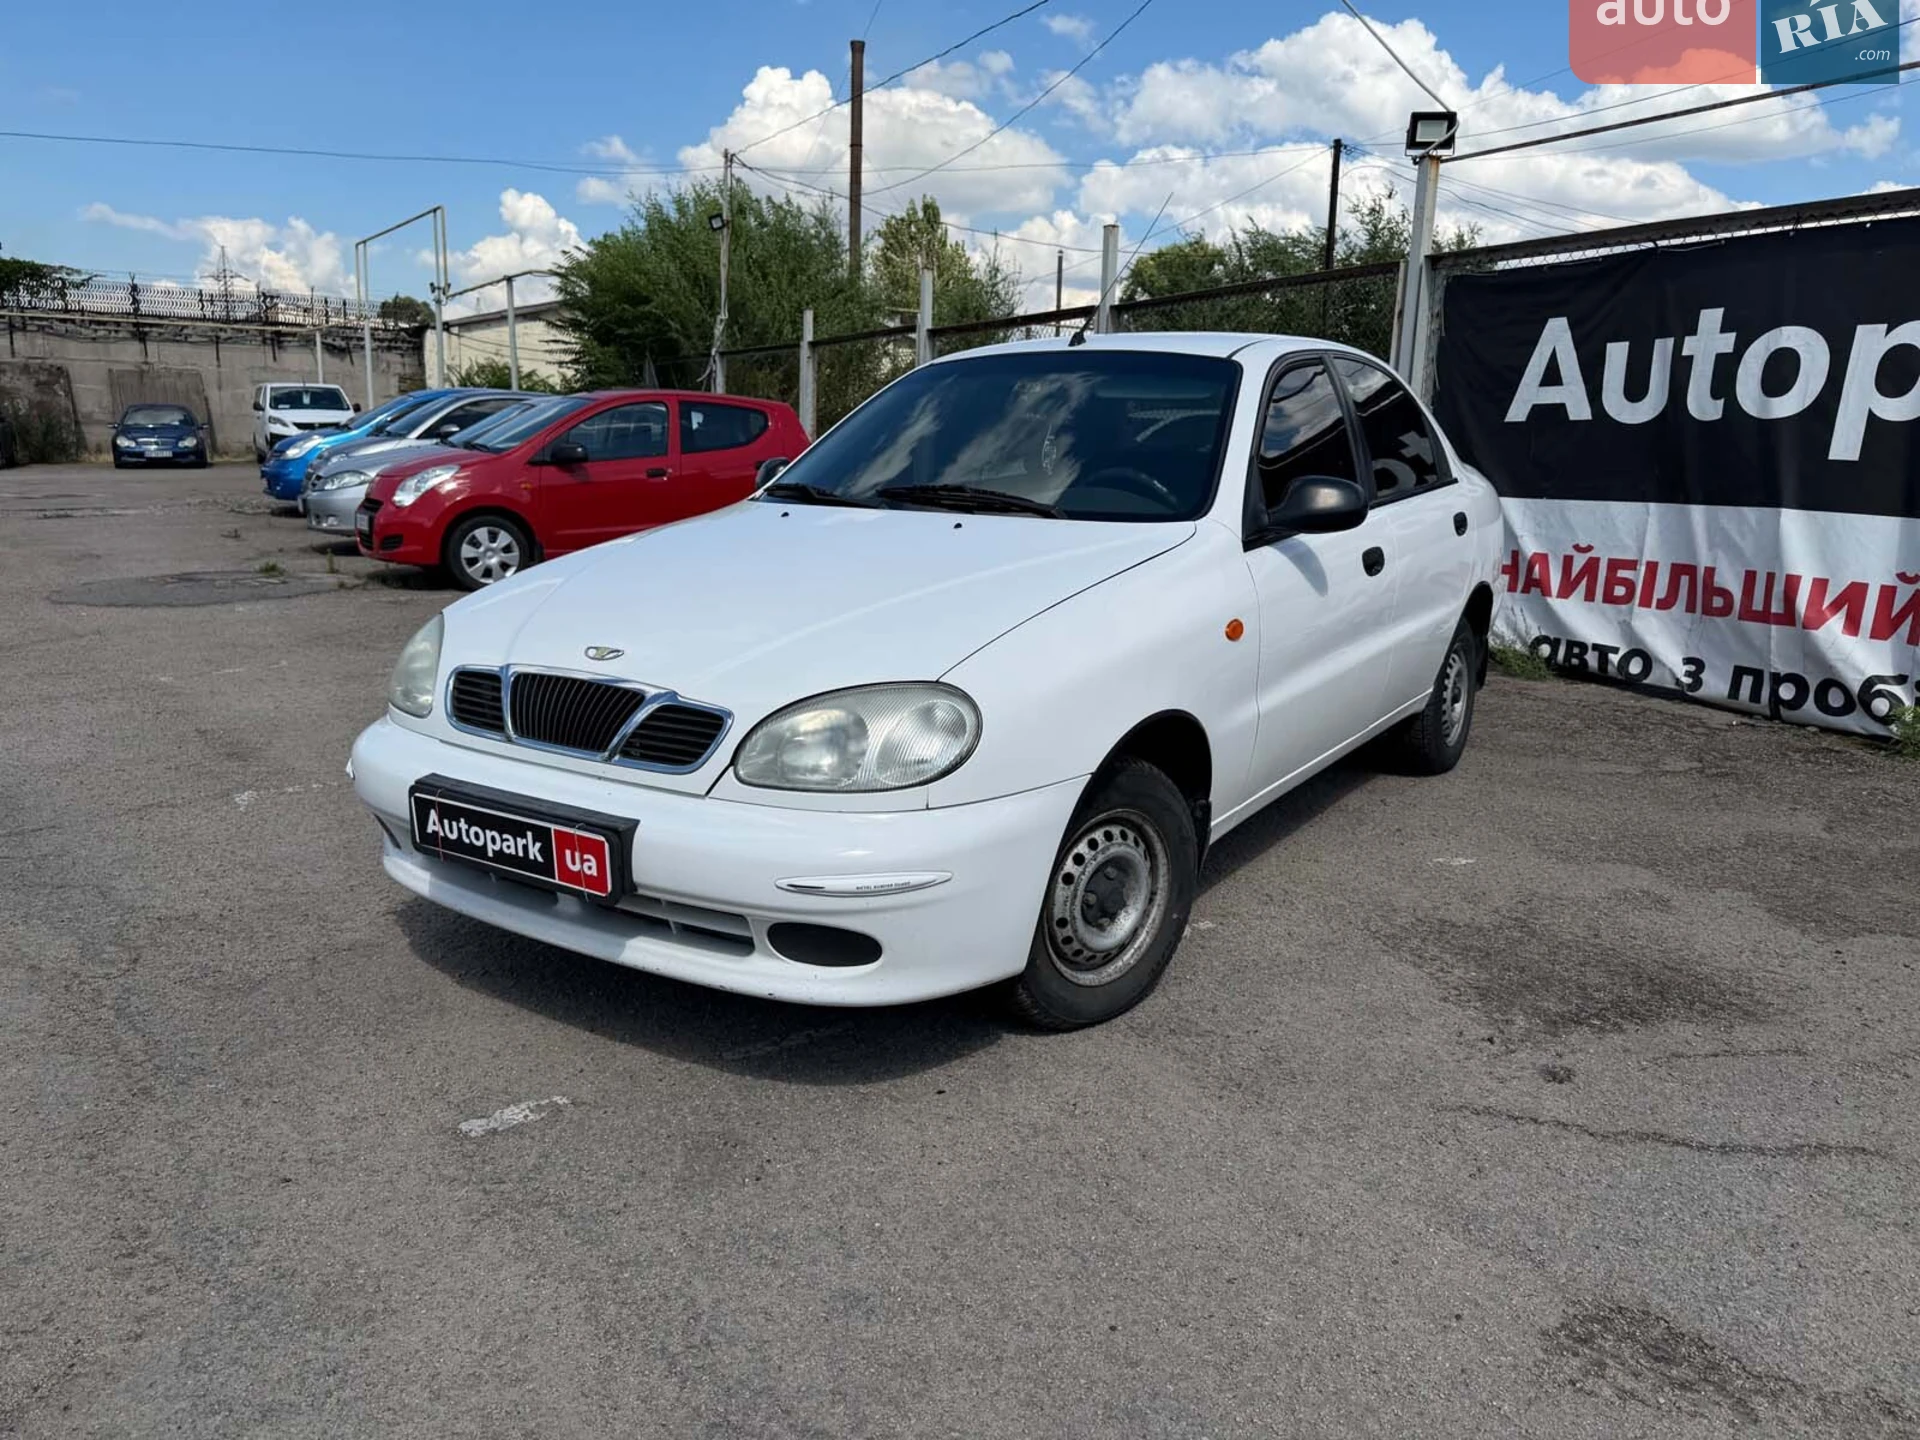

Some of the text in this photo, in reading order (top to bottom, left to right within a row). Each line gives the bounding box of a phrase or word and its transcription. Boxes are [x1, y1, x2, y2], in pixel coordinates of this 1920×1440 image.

[1504, 307, 1920, 462] Autop
[1529, 634, 1654, 683] авто
[426, 808, 598, 877] Autopark ua
